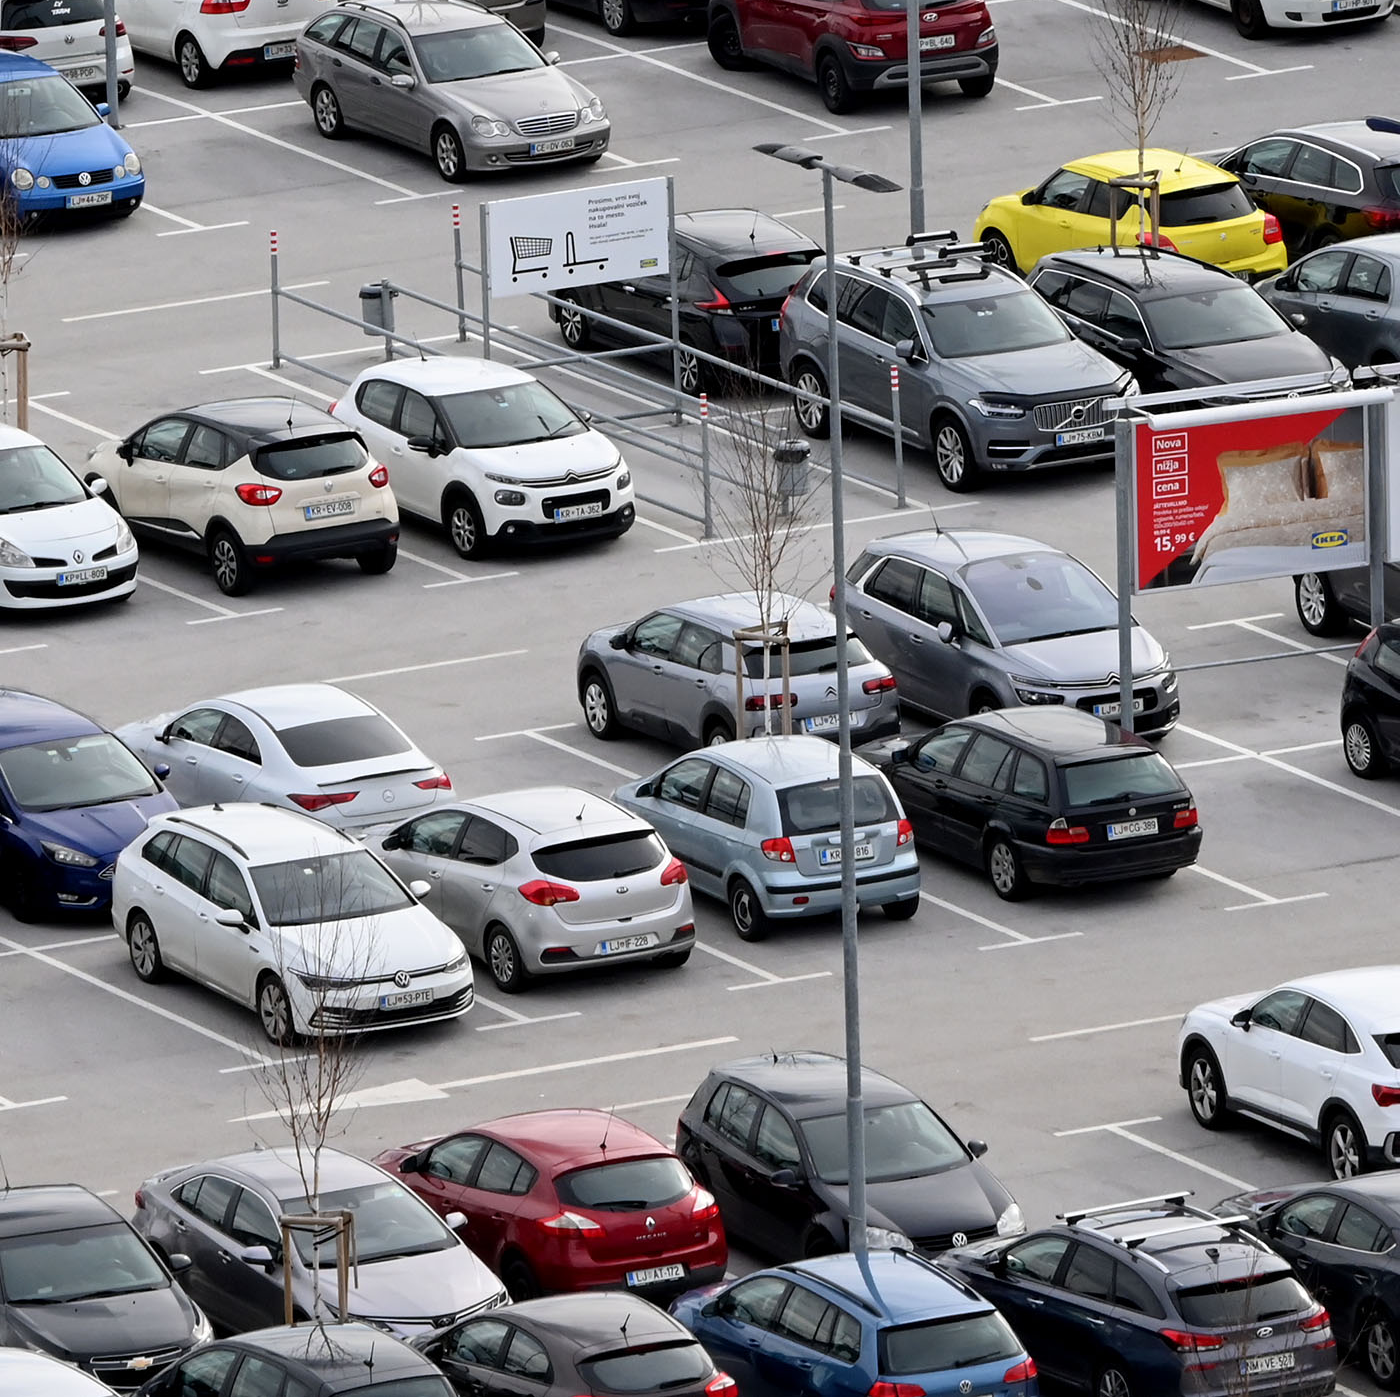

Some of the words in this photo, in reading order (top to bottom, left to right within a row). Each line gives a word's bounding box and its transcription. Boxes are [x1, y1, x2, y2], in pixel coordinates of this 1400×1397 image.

[85, 195, 110, 204] 44-ZRF
[1156, 439, 1182, 450] Nova
[1156, 460, 1179, 472] nižja
[1157, 482, 1180, 492] cena
[327, 502, 352, 513] EV-008
[576, 505, 599, 515] TA-362
[1154, 533, 1186, 552] 15,99
[1188, 532, 1195, 541] €
[81, 569, 105, 580] LL-809
[1129, 821, 1156, 832] CG-389
[626, 937, 648, 948] IF-228
[403, 992, 430, 1003] 53-PTE
[654, 1266, 680, 1279] AT-172
